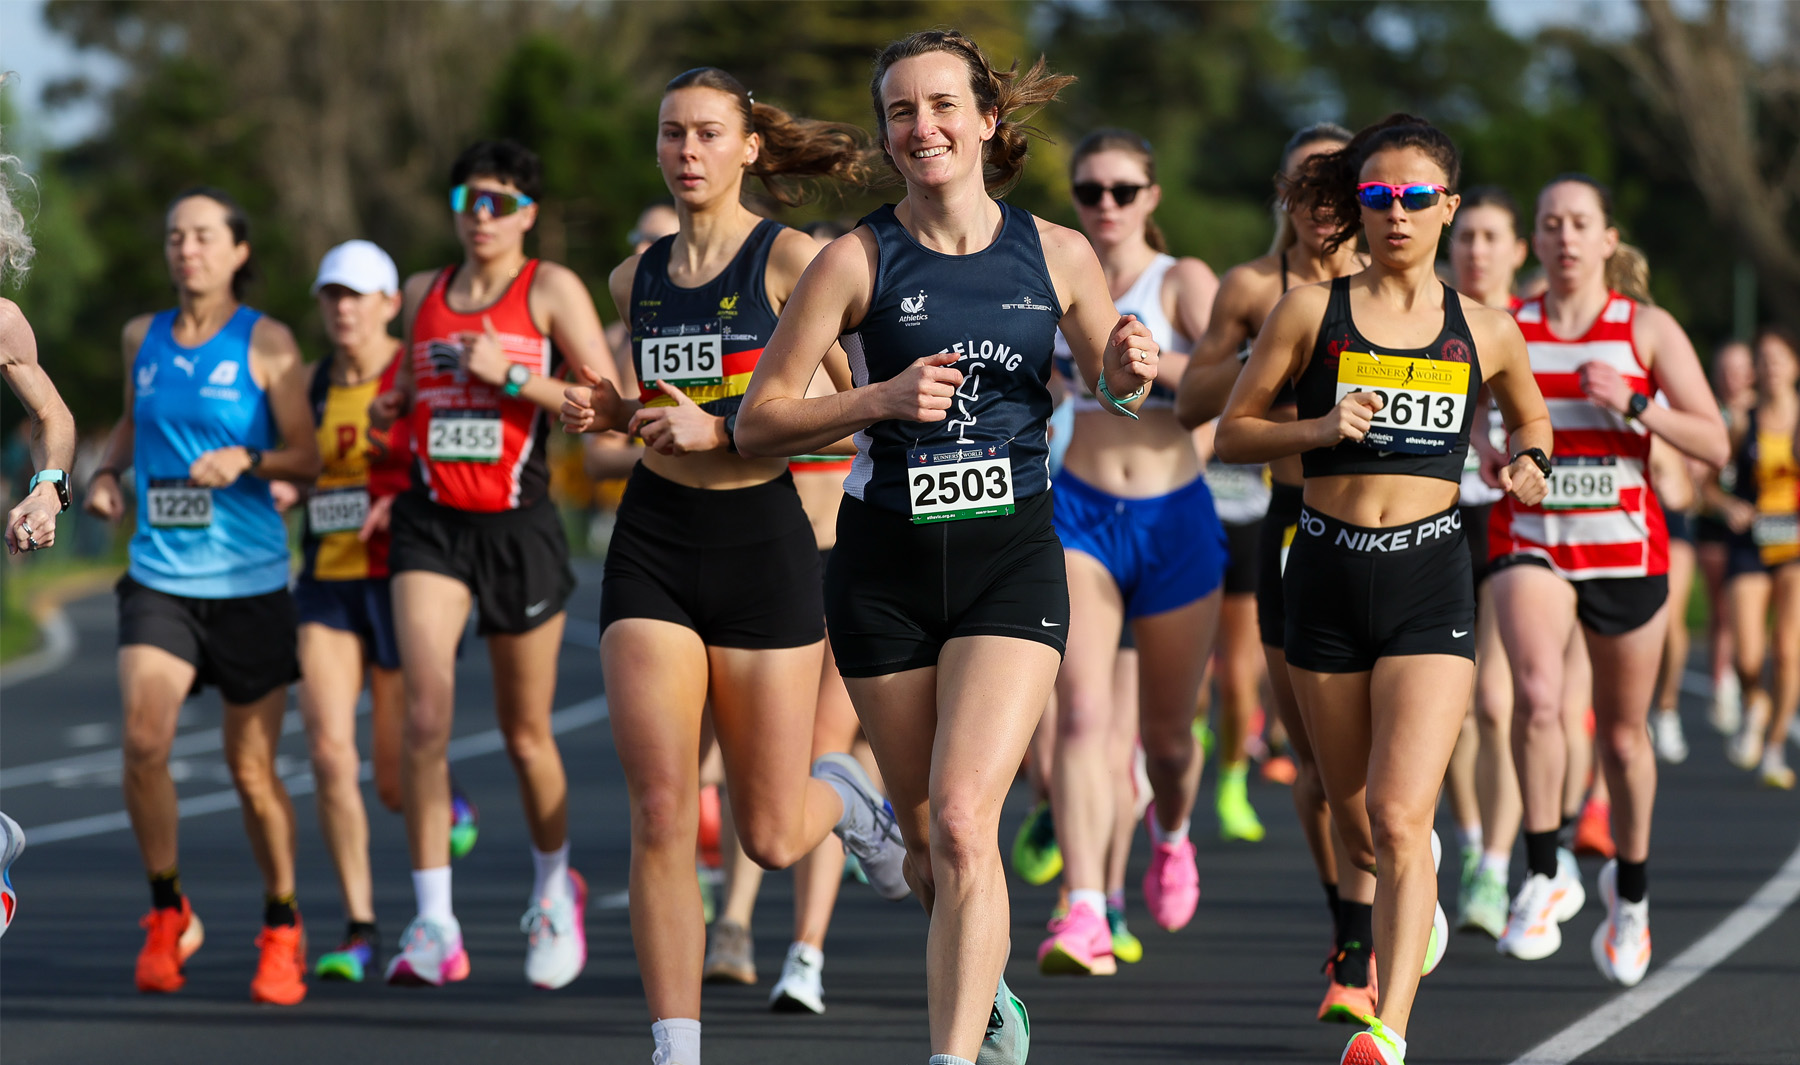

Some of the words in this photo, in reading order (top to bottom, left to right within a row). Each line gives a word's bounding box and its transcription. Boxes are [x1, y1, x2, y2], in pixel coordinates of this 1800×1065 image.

[899, 313, 929, 323] Athletics
[1001, 303, 1052, 311] STEIGEN
[722, 333, 758, 341] IGEN
[648, 341, 715, 374] 1515
[938, 340, 1023, 372] ELONG
[1356, 364, 1406, 377] RUNNERS
[1415, 370, 1453, 382] WORLD
[1347, 387, 1455, 429] 2613
[432, 424, 497, 450] 2455
[933, 453, 959, 462] RUNNERS
[913, 465, 1008, 507] 2503
[1550, 473, 1613, 497] 1698
[154, 494, 208, 517] 1220
[1300, 508, 1326, 537] RO
[1334, 528, 1412, 553] NIKE
[1415, 508, 1462, 546] PRO
